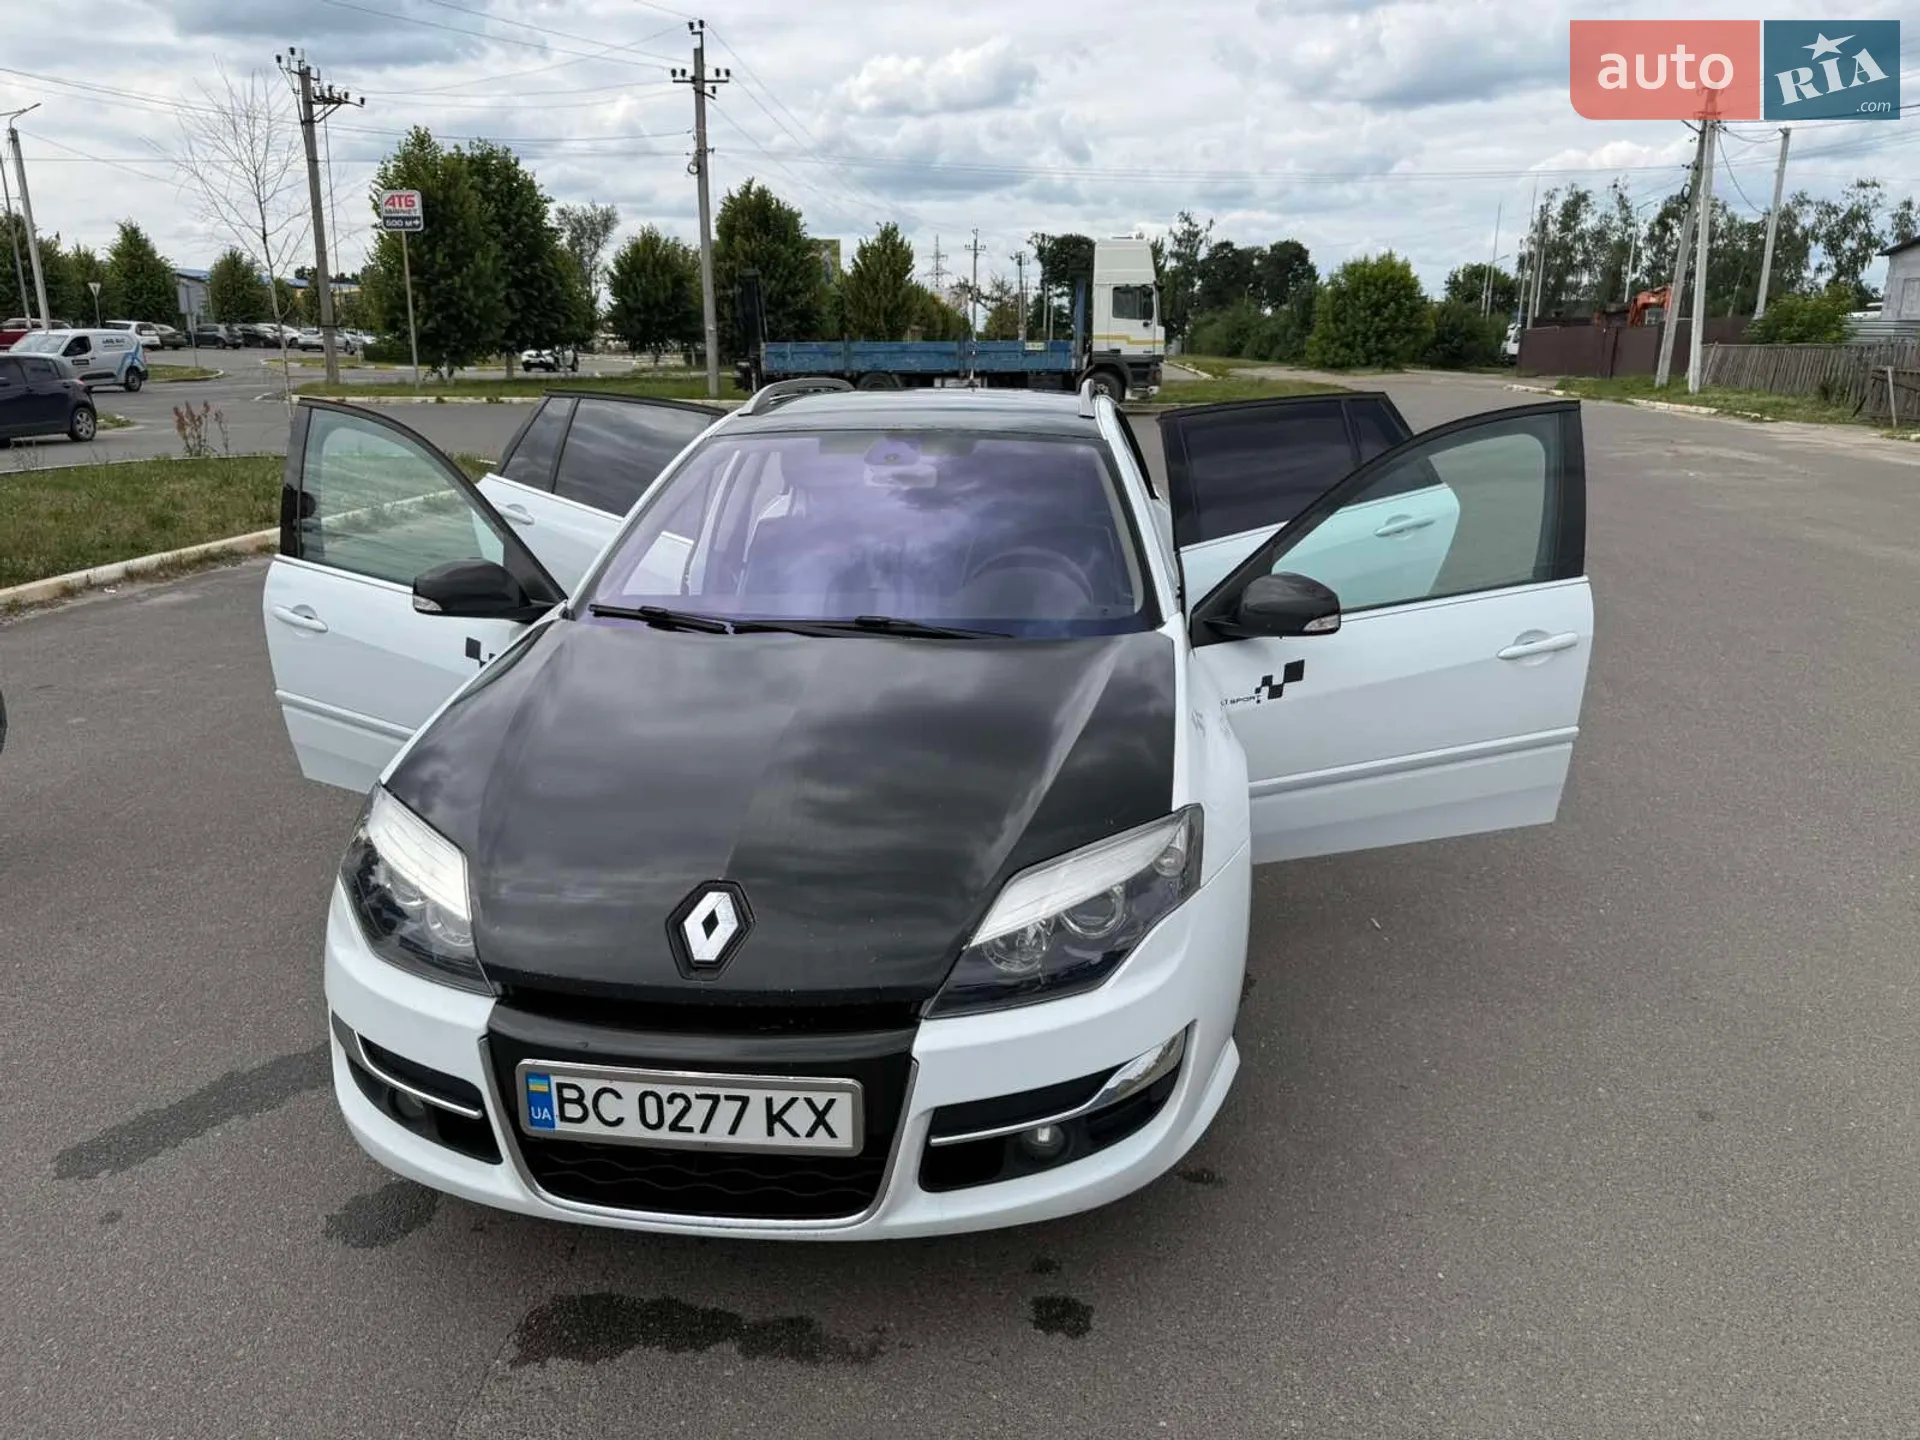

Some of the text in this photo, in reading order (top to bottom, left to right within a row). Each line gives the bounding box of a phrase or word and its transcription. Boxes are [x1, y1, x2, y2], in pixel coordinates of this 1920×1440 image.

[384, 193, 416, 208] АТБ
[531, 1106, 552, 1121] UA
[555, 1081, 839, 1139] BC 0277 KX
